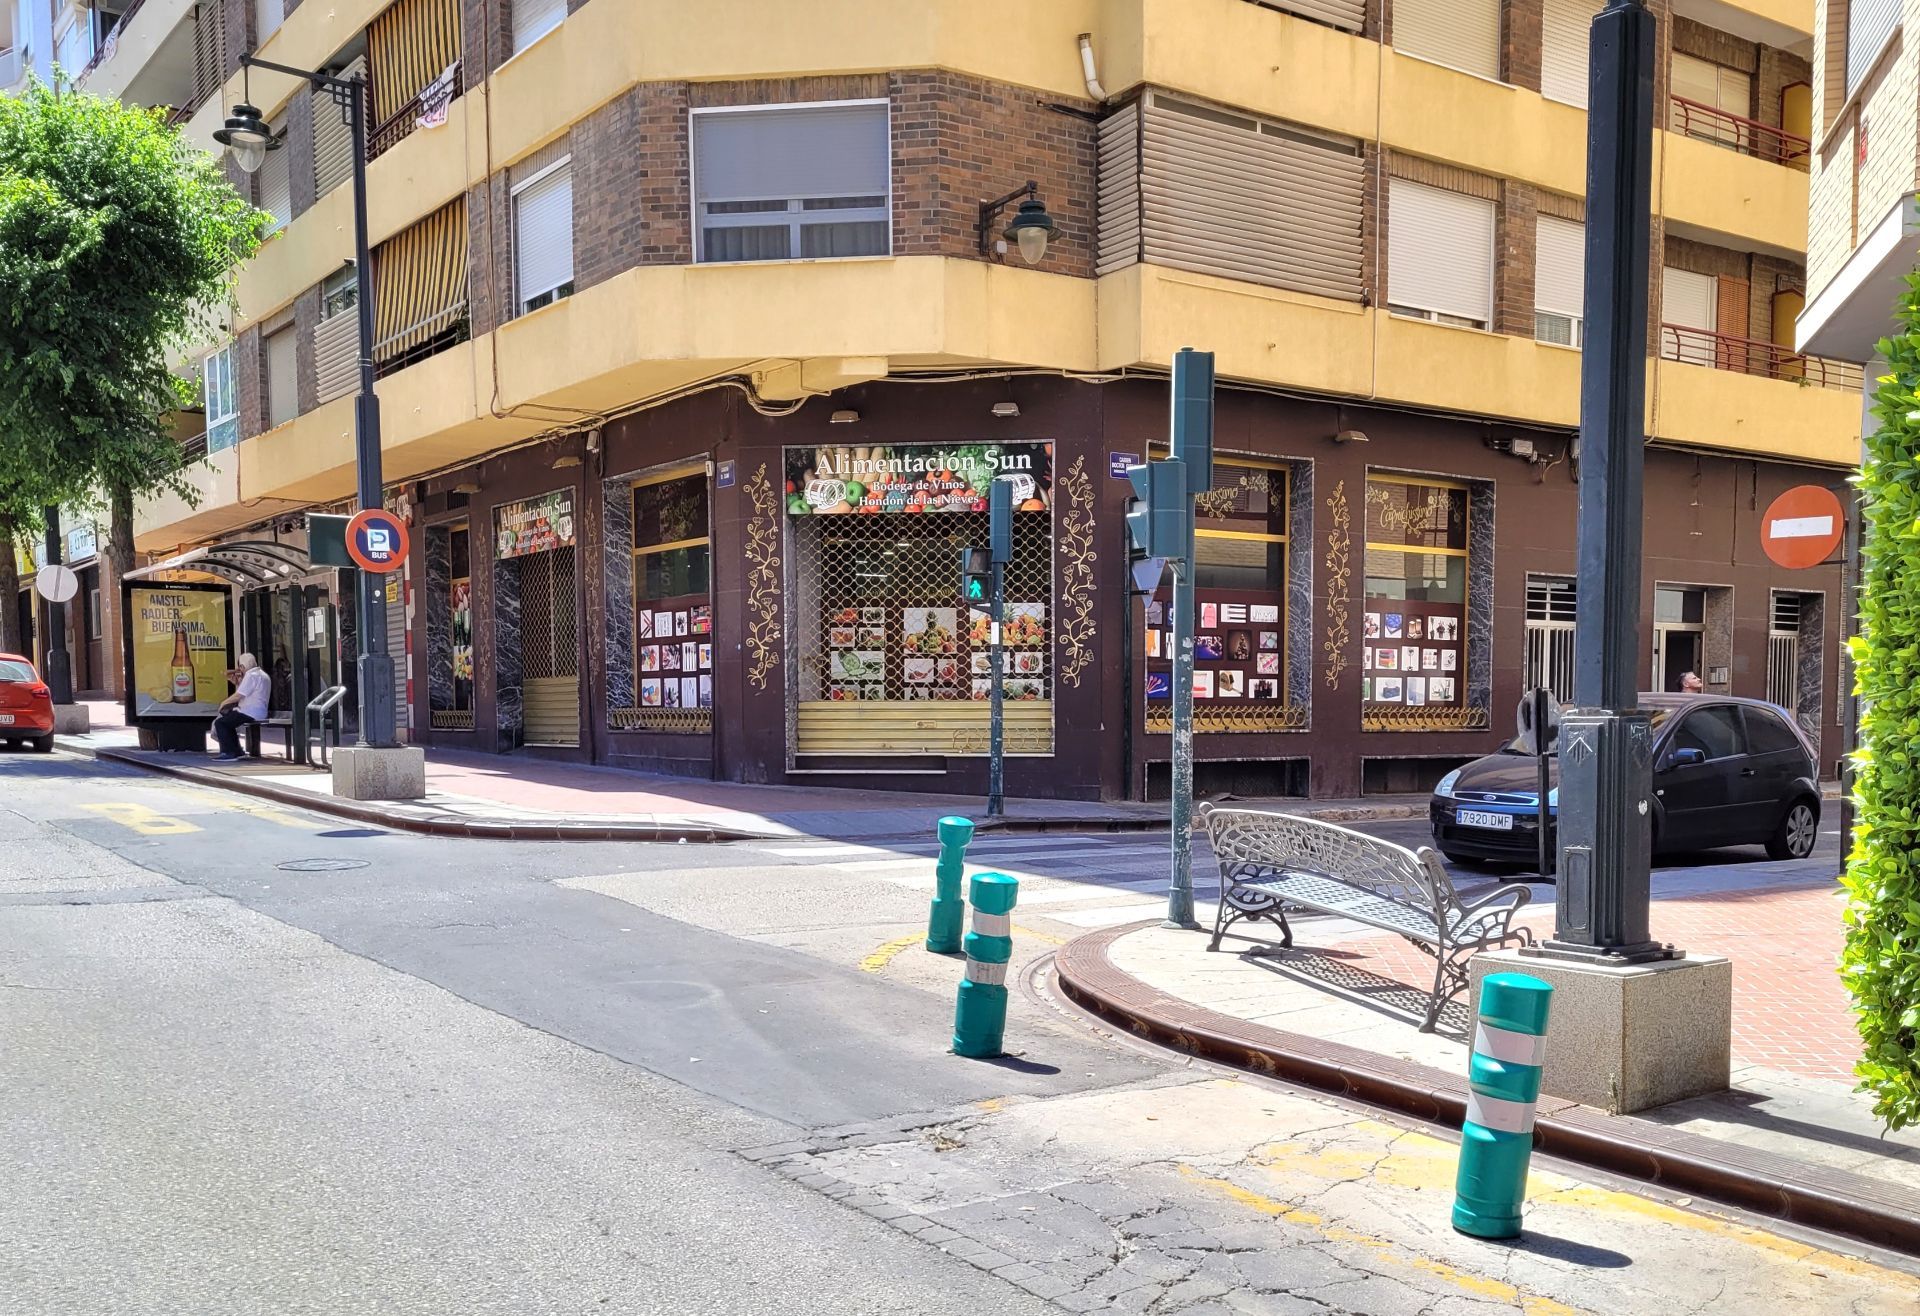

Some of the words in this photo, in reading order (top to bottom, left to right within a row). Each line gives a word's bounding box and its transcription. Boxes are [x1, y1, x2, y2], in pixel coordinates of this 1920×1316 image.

[815, 450, 976, 475] Alimentación
[984, 449, 1033, 470] Sun
[872, 481, 914, 493] Bodega
[916, 481, 929, 490] de
[932, 480, 965, 490] Vinos
[859, 496, 904, 506] Hondón
[906, 495, 920, 505] de
[923, 494, 938, 505] las
[941, 494, 979, 505] Nieves
[502, 503, 553, 529] Alimentación
[554, 498, 572, 515] Sun
[371, 551, 388, 559] BUS
[149, 594, 191, 607] AMSTEL.
[141, 607, 183, 620] RADLER.
[189, 633, 222, 648] LIMÓN.
[1463, 812, 1488, 825] 7920
[1490, 815, 1510, 828] DMF
